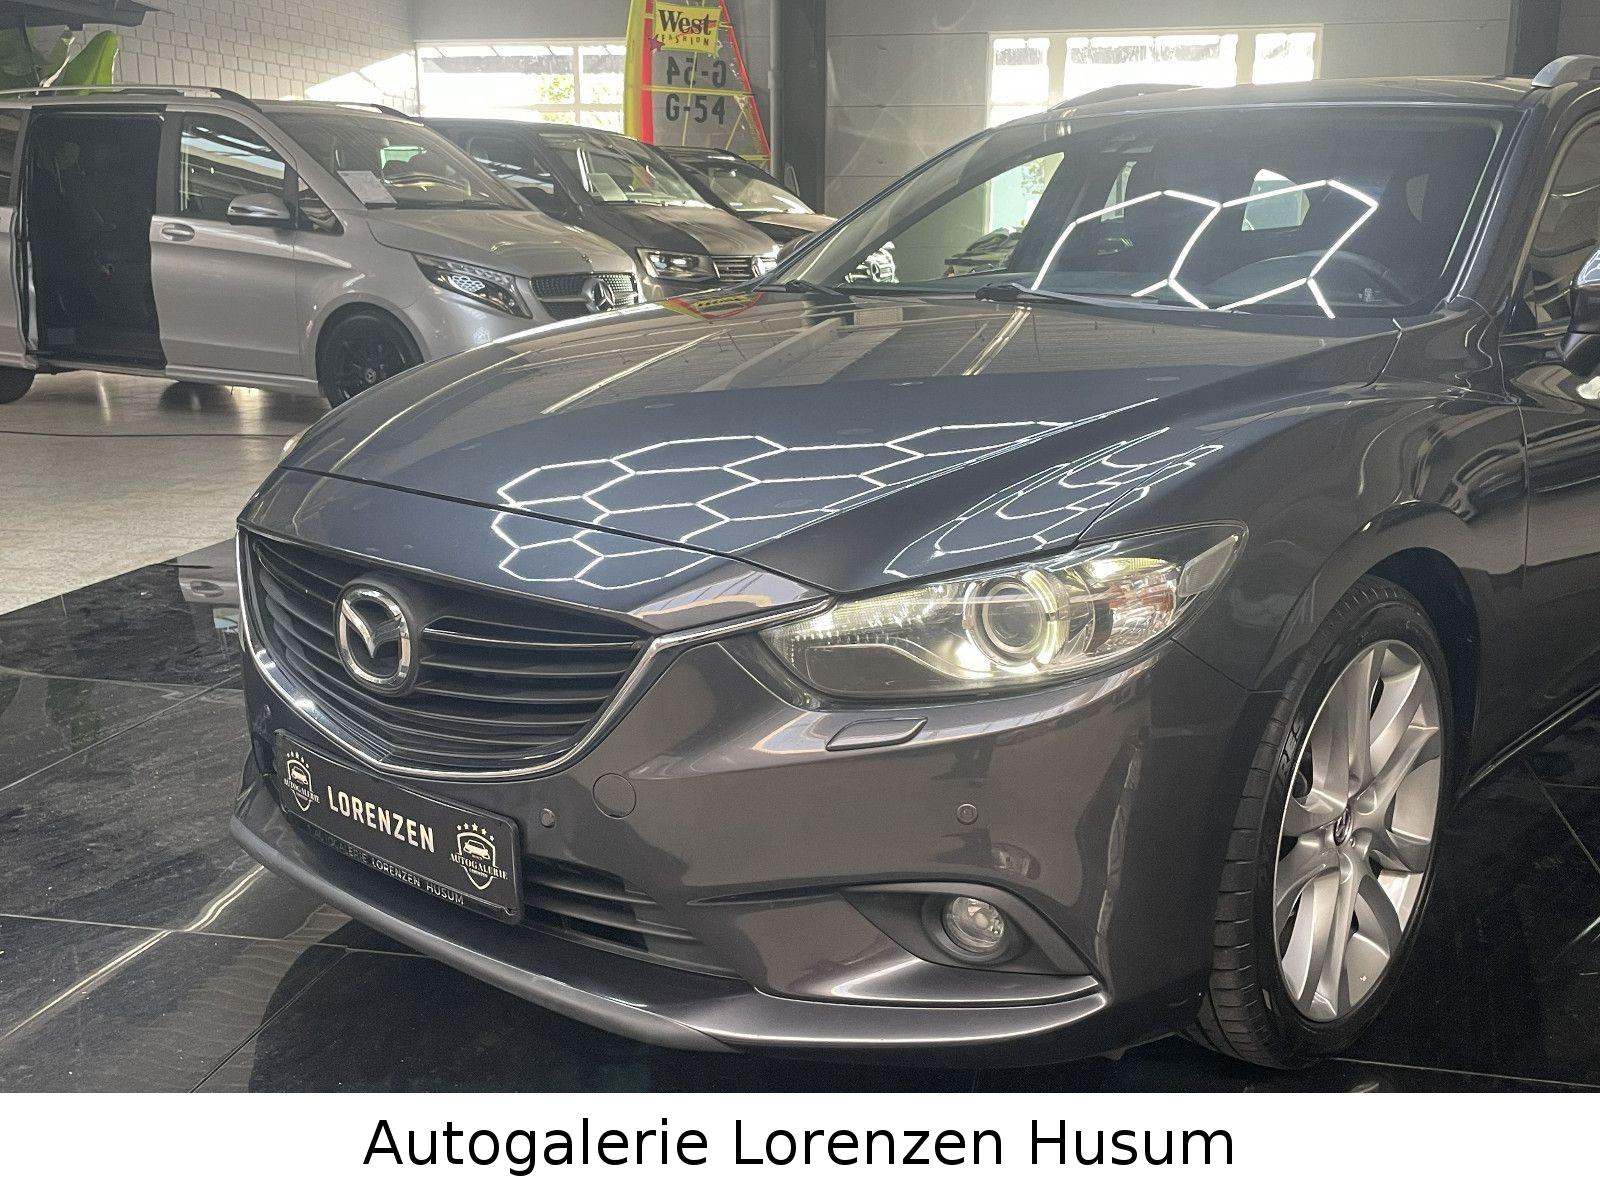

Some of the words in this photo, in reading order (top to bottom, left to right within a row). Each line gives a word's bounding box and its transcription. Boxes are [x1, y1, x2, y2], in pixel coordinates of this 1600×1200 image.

[658, 9, 711, 36] West
[660, 34, 710, 46] FASHION
[665, 93, 726, 125] G-54
[327, 785, 436, 853] LORENZEN
[450, 852, 508, 880] AUTOGALERIE
[371, 857, 421, 887] LORENZEN
[426, 884, 465, 906] HUSUM
